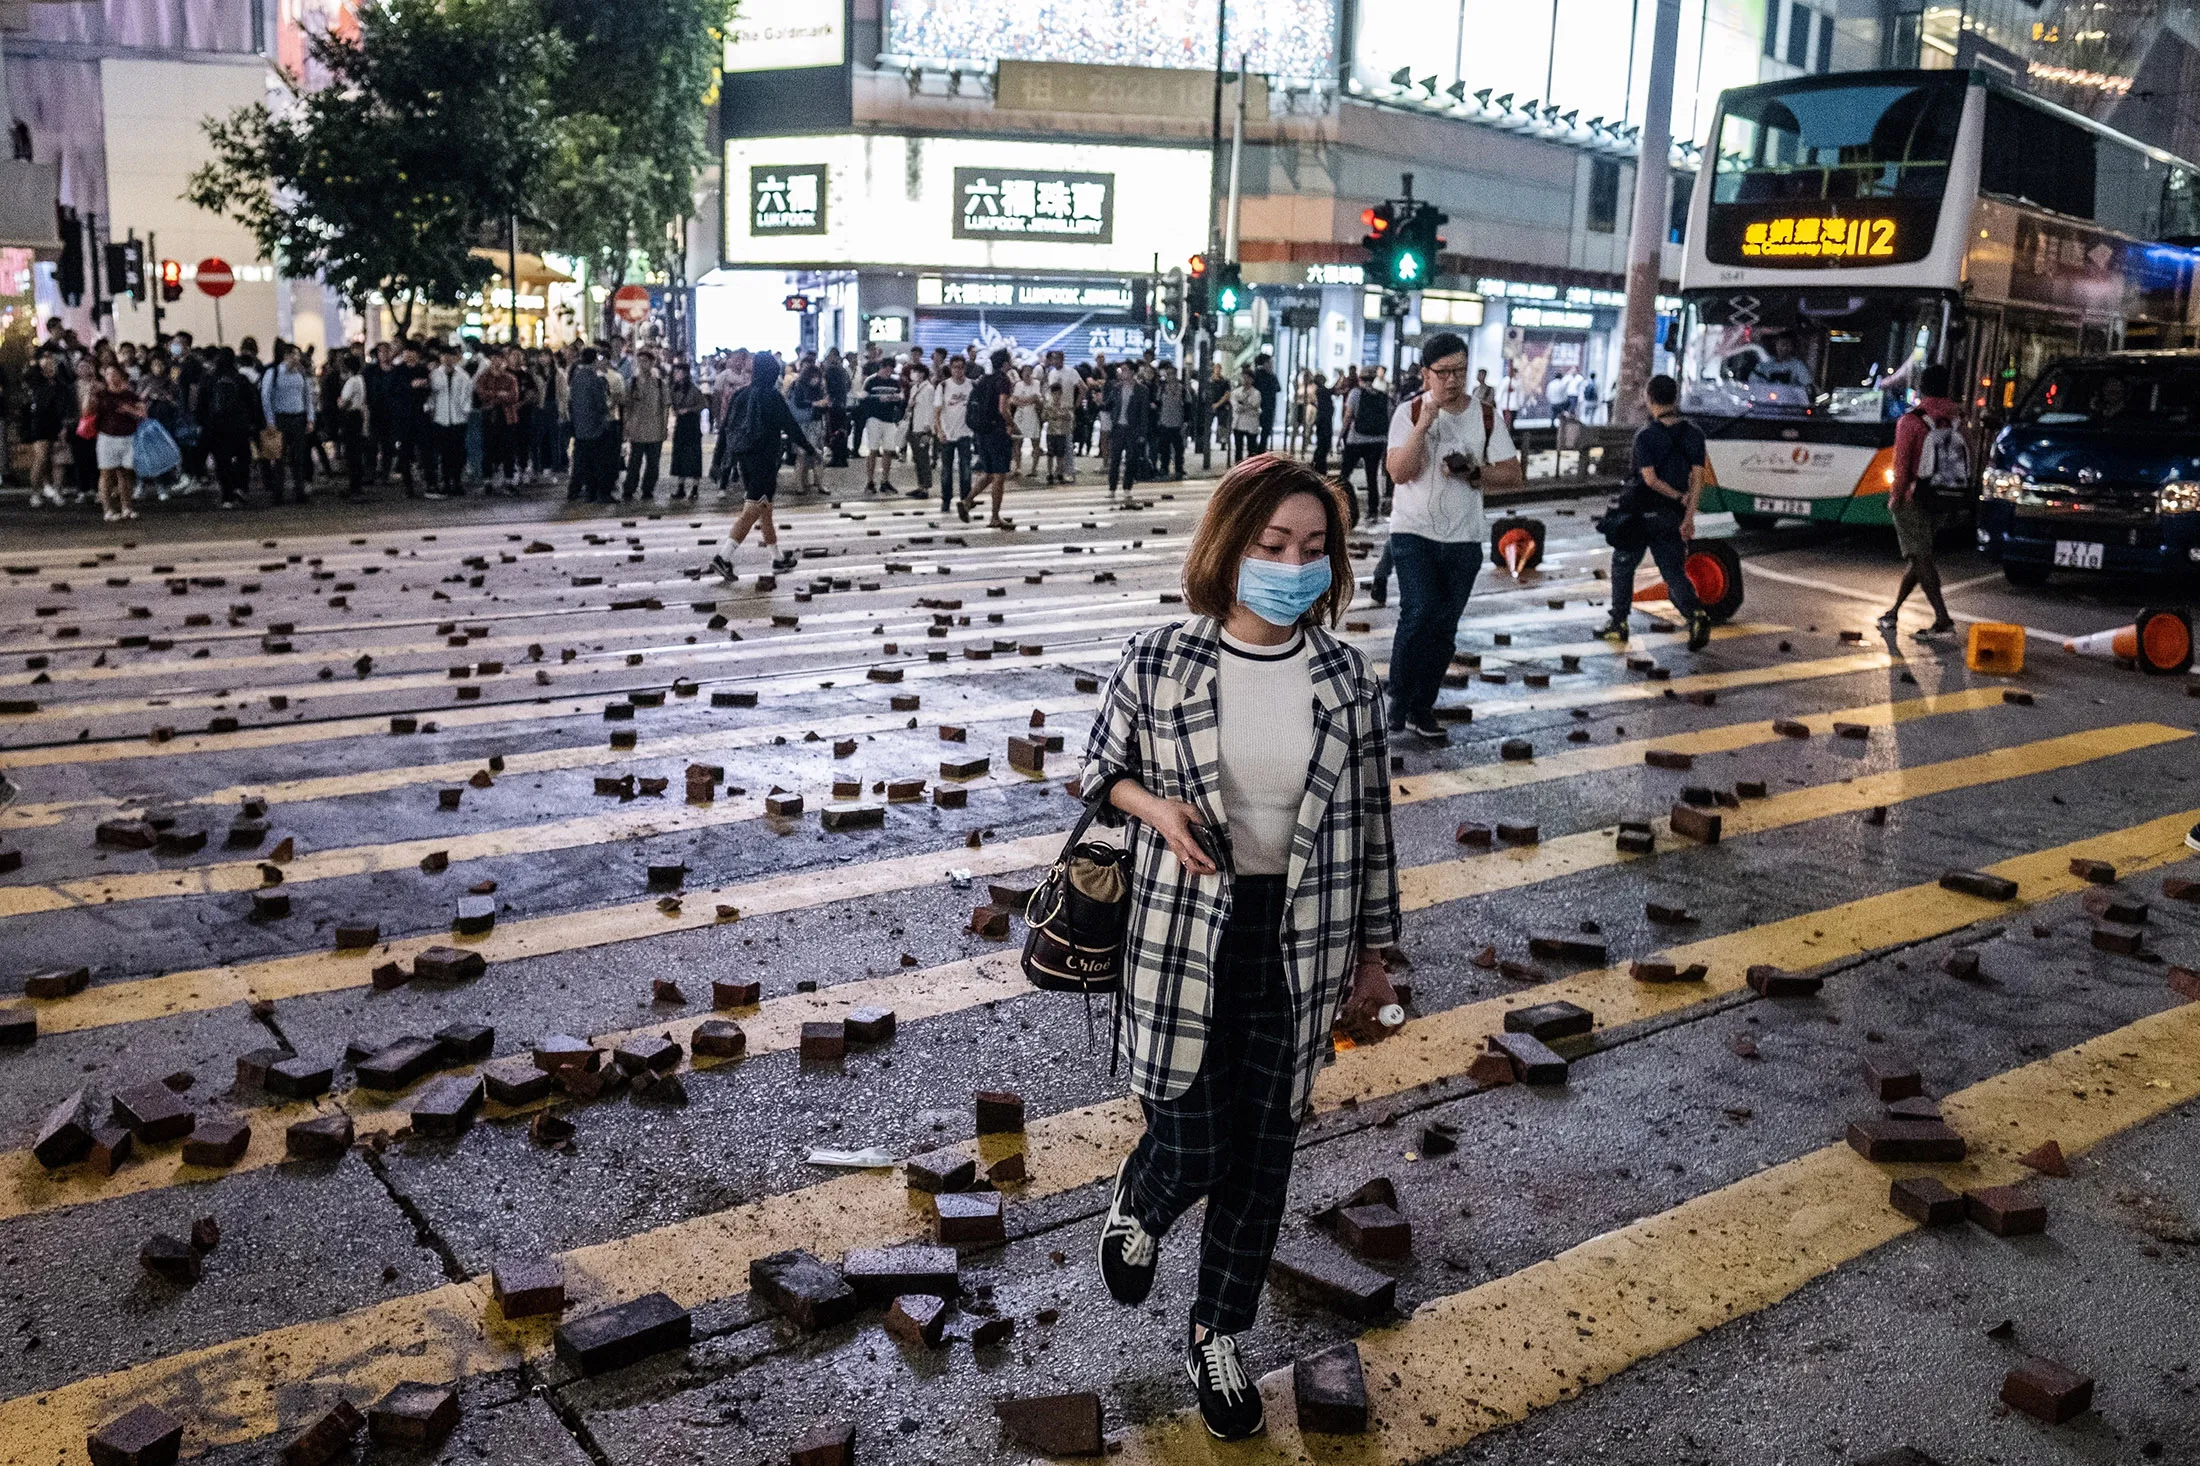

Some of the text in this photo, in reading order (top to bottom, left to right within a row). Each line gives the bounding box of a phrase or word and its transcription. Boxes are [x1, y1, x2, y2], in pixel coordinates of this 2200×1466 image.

[757, 174, 818, 213] 六福
[964, 178, 1106, 219] 六福珠寶
[756, 211, 816, 228] LUKFOOK
[964, 215, 1027, 232] LUKFOOK
[1846, 219, 1896, 255] 112
[1066, 955, 1111, 971] Chloé
